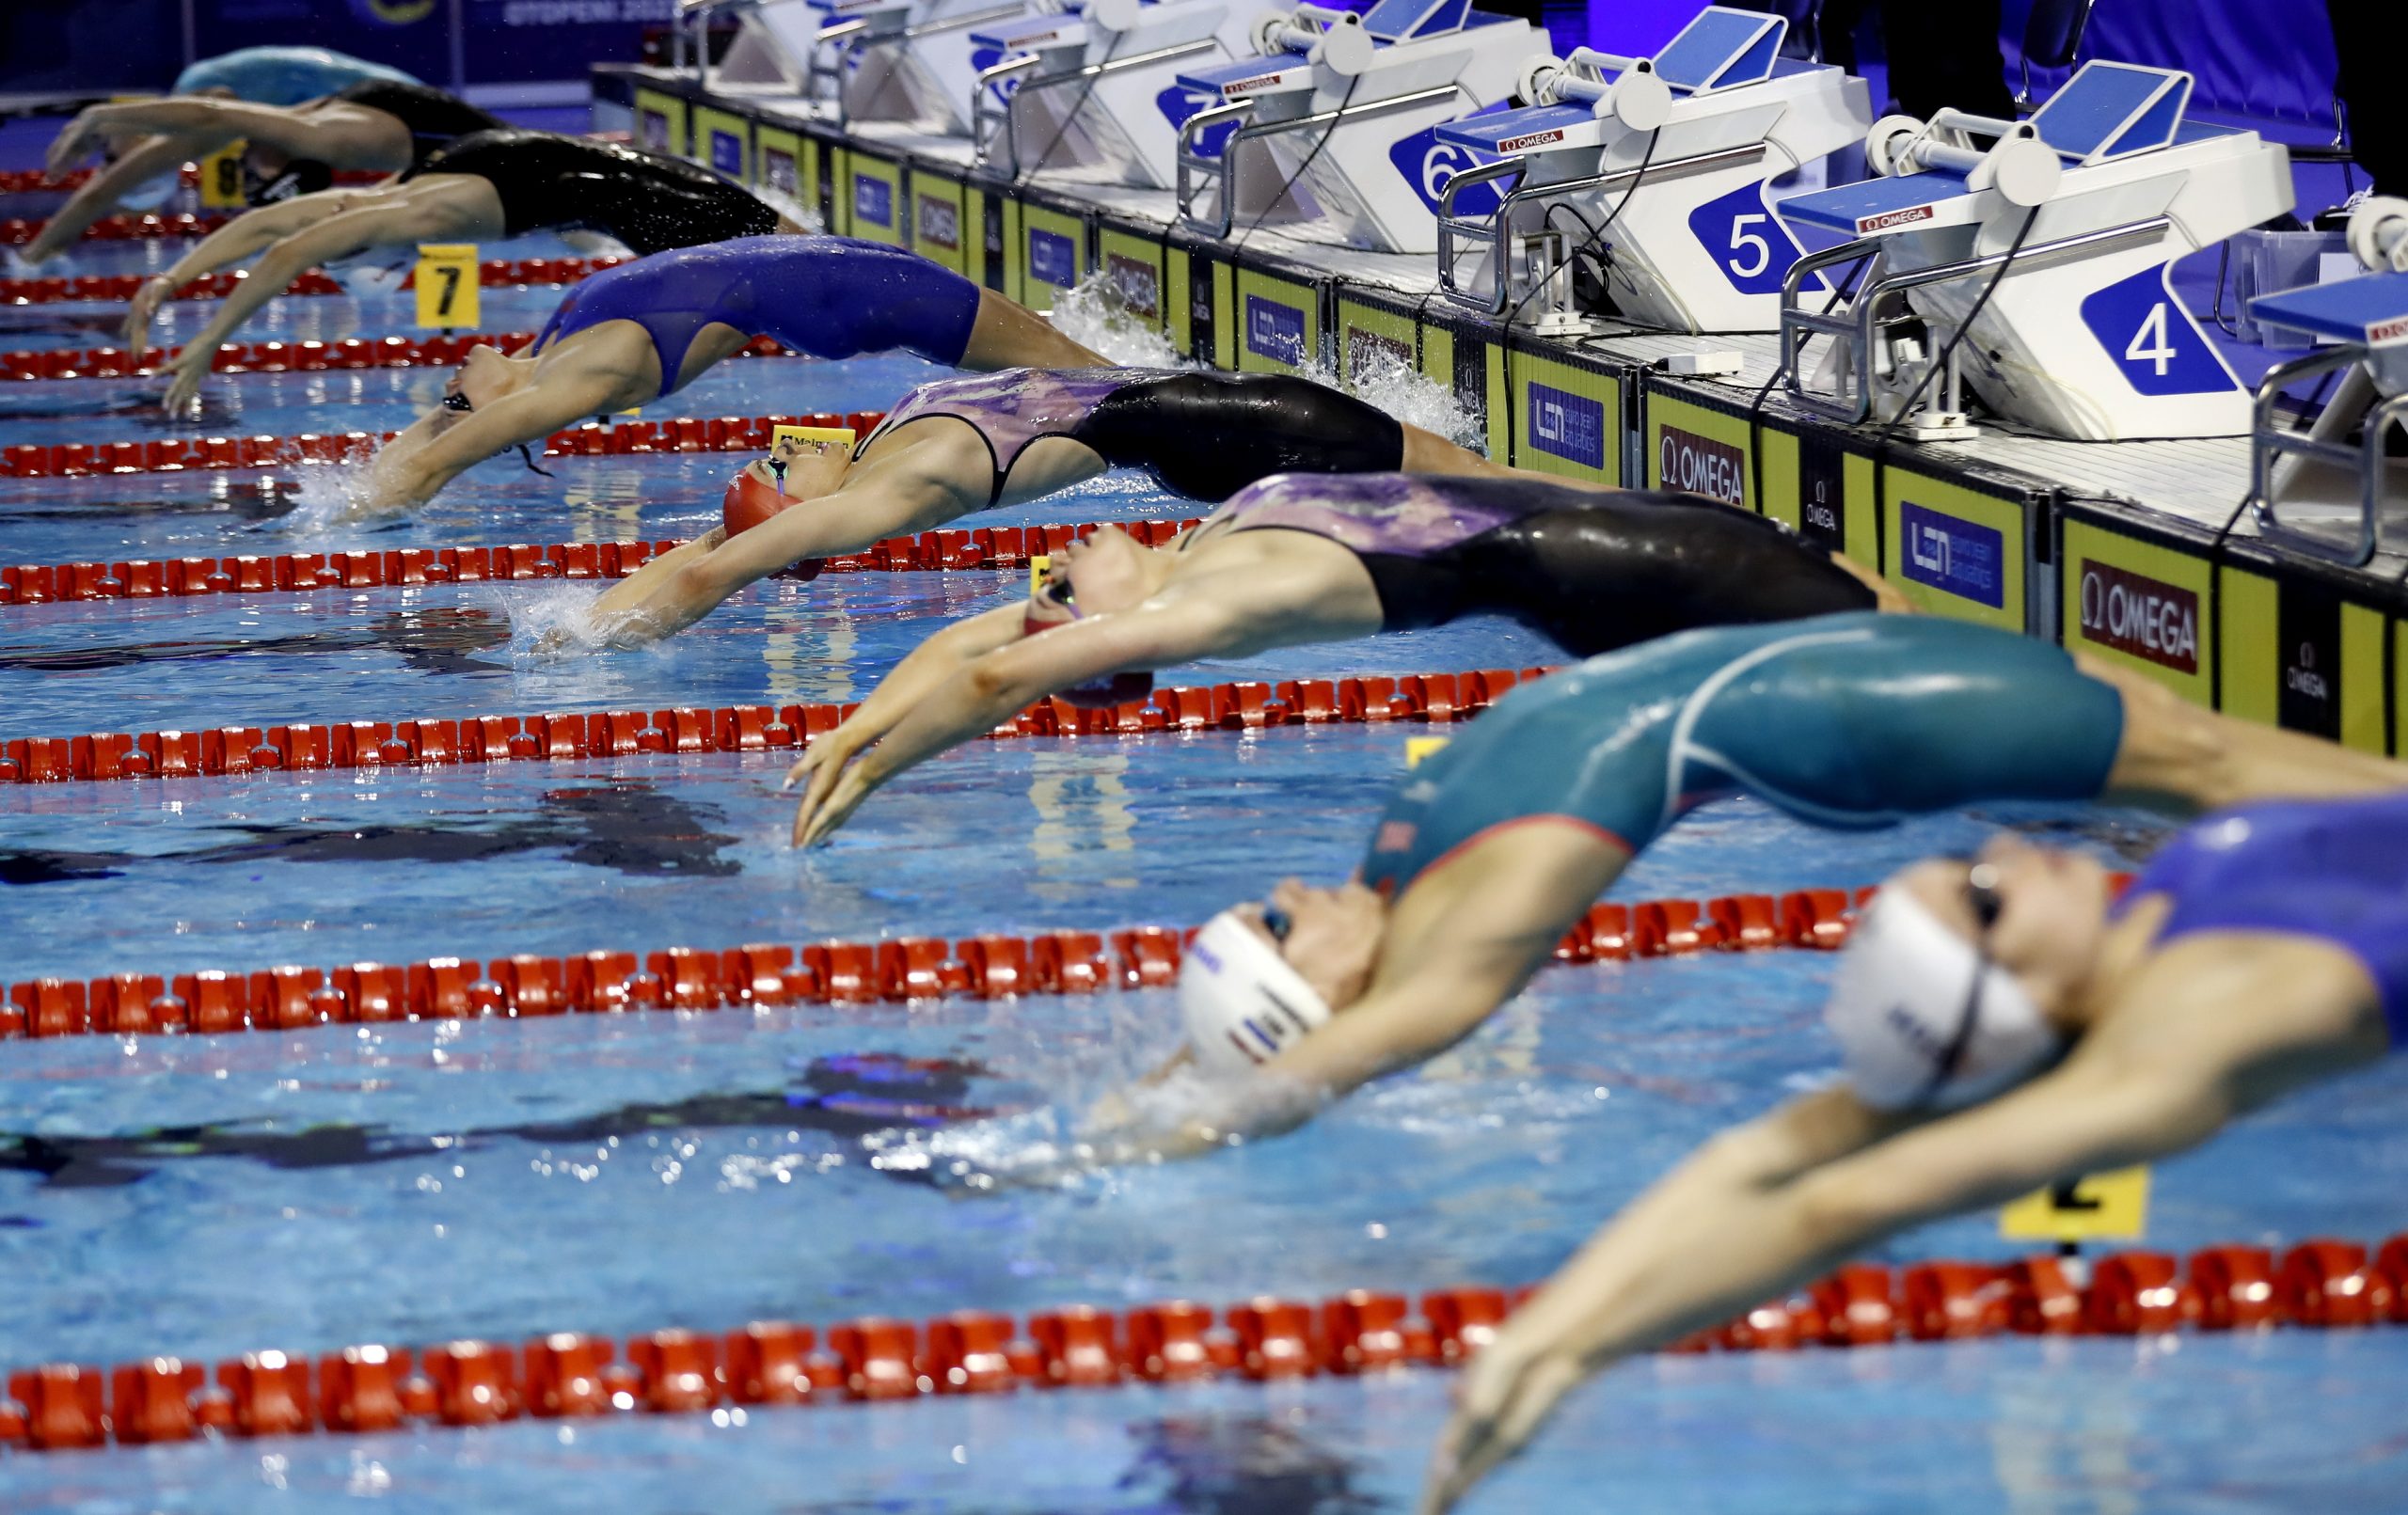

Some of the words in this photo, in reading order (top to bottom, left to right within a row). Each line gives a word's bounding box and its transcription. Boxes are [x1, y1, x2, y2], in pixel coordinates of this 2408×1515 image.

[1185, 94, 1218, 145] 7
[1518, 133, 1557, 148] OMEGA
[1422, 144, 1458, 201] 6
[1729, 213, 1769, 277] 5
[1880, 210, 1926, 227] OMEGA
[436, 267, 462, 317] 7
[2125, 302, 2177, 375] 4
[1681, 446, 1743, 506] OMEGA
[1806, 503, 1836, 531] OMEGA
[2108, 584, 2195, 661] OMEGA
